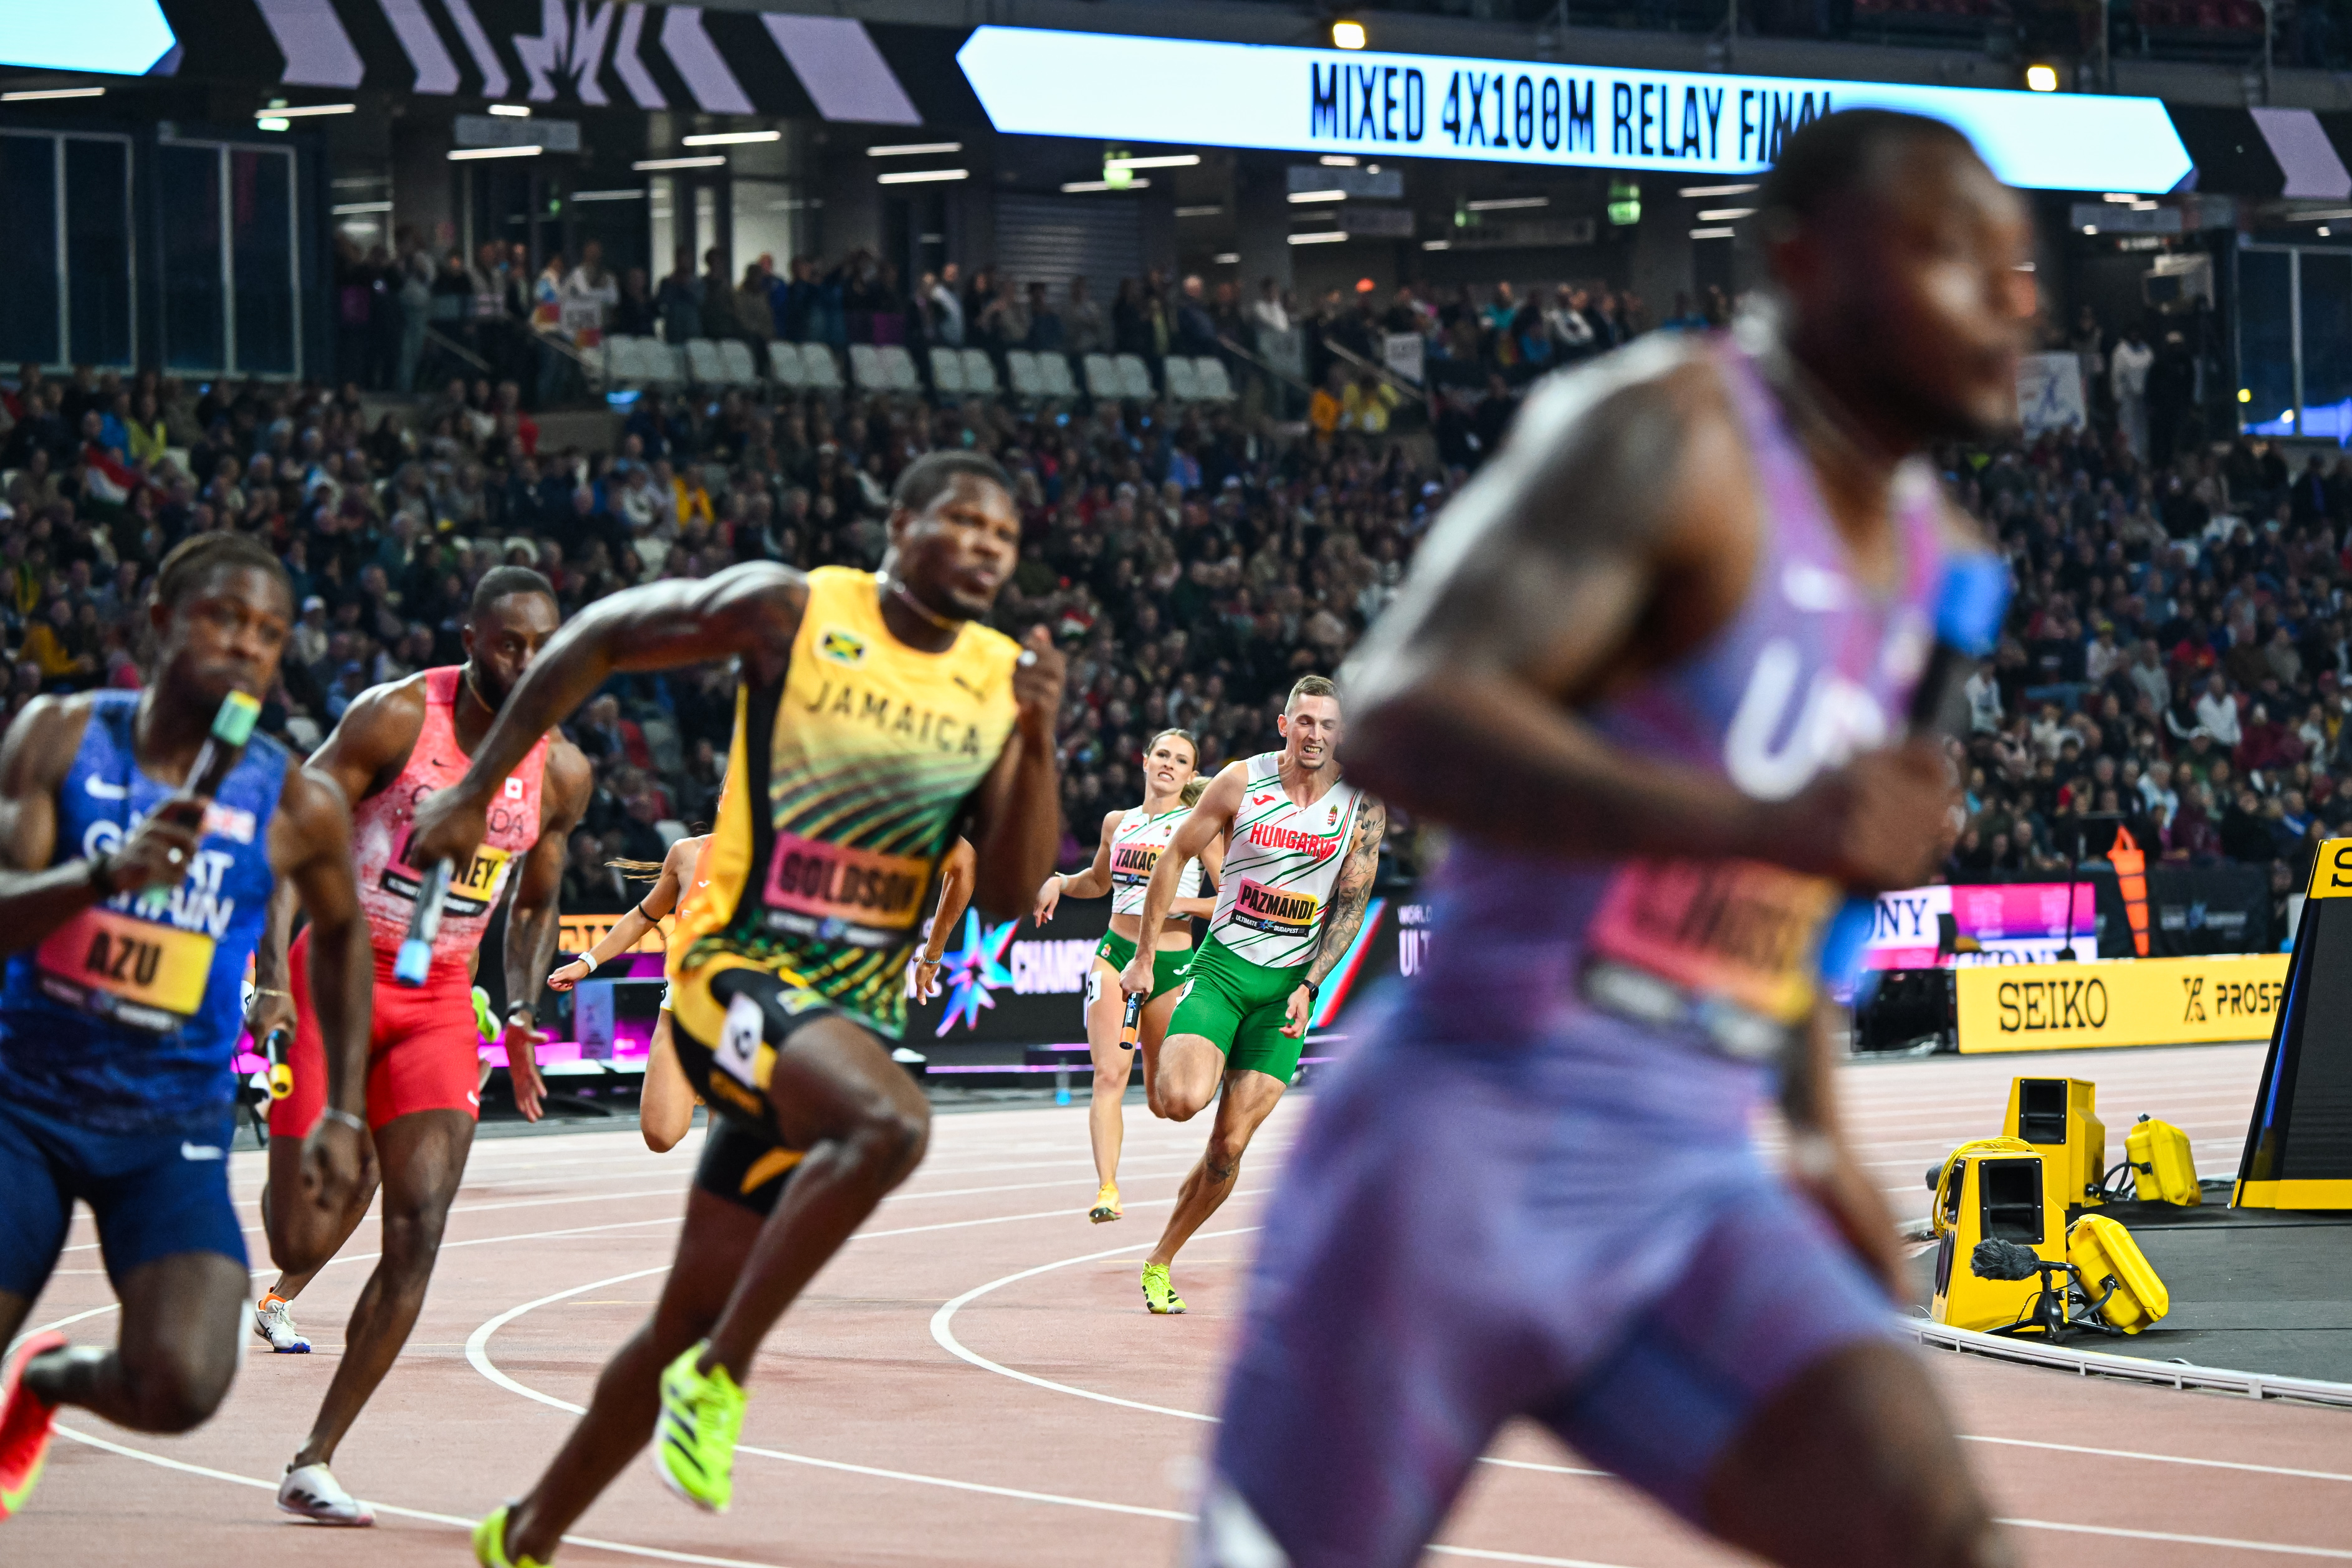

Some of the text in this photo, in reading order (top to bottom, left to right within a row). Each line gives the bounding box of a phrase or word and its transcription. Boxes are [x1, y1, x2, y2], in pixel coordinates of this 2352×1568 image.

[1312, 62, 1424, 141] MIXED
[1613, 82, 1723, 160] RELAY
[804, 681, 982, 761] JAMAICA
[1249, 821, 1332, 861] HUNGARY
[1235, 914, 1258, 927] ULTIMATE
[1240, 884, 1316, 920] PÁZMÁNDI
[1876, 897, 1928, 937] NY
[86, 931, 162, 987] AZU
[1998, 978, 2108, 1033] SEIKO
[2216, 982, 2283, 1015] PROSP
